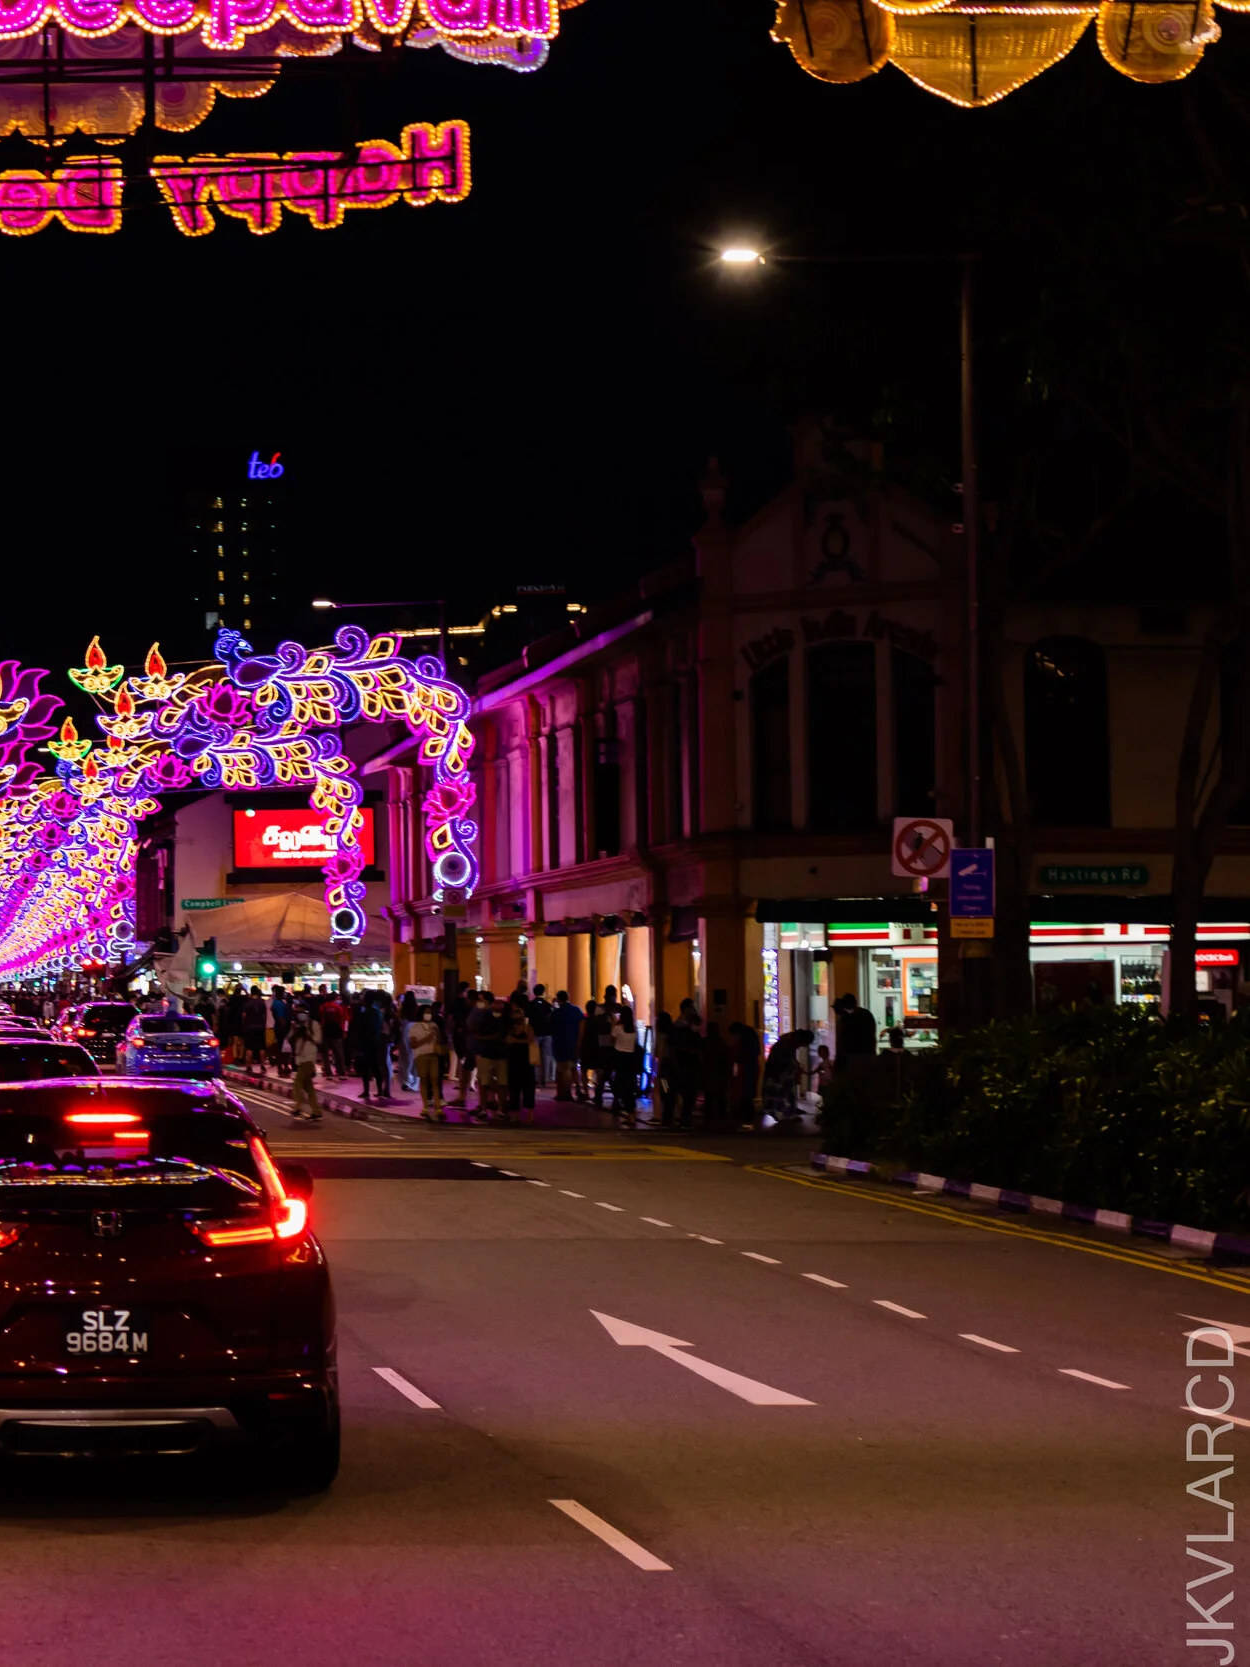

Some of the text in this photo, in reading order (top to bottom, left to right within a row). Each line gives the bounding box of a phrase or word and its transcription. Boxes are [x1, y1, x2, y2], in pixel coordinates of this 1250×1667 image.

[1048, 868, 1141, 884] Hastings Rd
[82, 1311, 131, 1331] SLZ
